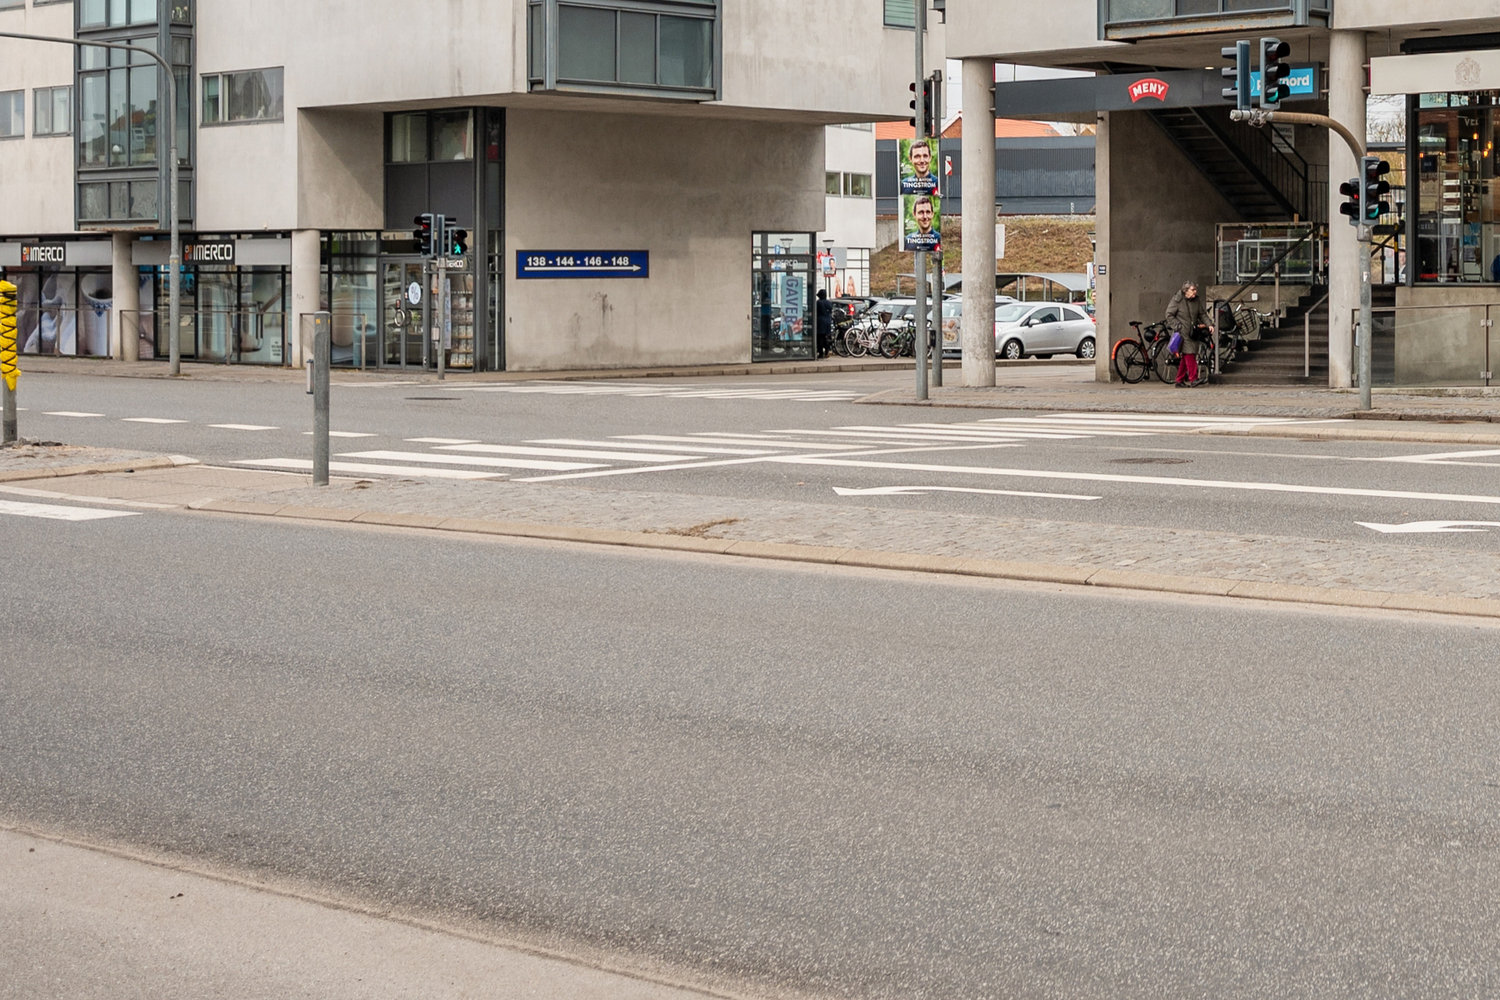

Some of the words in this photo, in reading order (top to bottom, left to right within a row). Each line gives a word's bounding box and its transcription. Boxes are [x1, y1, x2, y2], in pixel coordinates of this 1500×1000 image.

[1132, 82, 1165, 97] MENY
[30, 246, 64, 262] IMERCO
[193, 244, 233, 261] IMERCO
[527, 256, 546, 266] 138
[555, 256, 574, 266] 144
[584, 256, 601, 266] 146
[611, 256, 629, 266] 148
